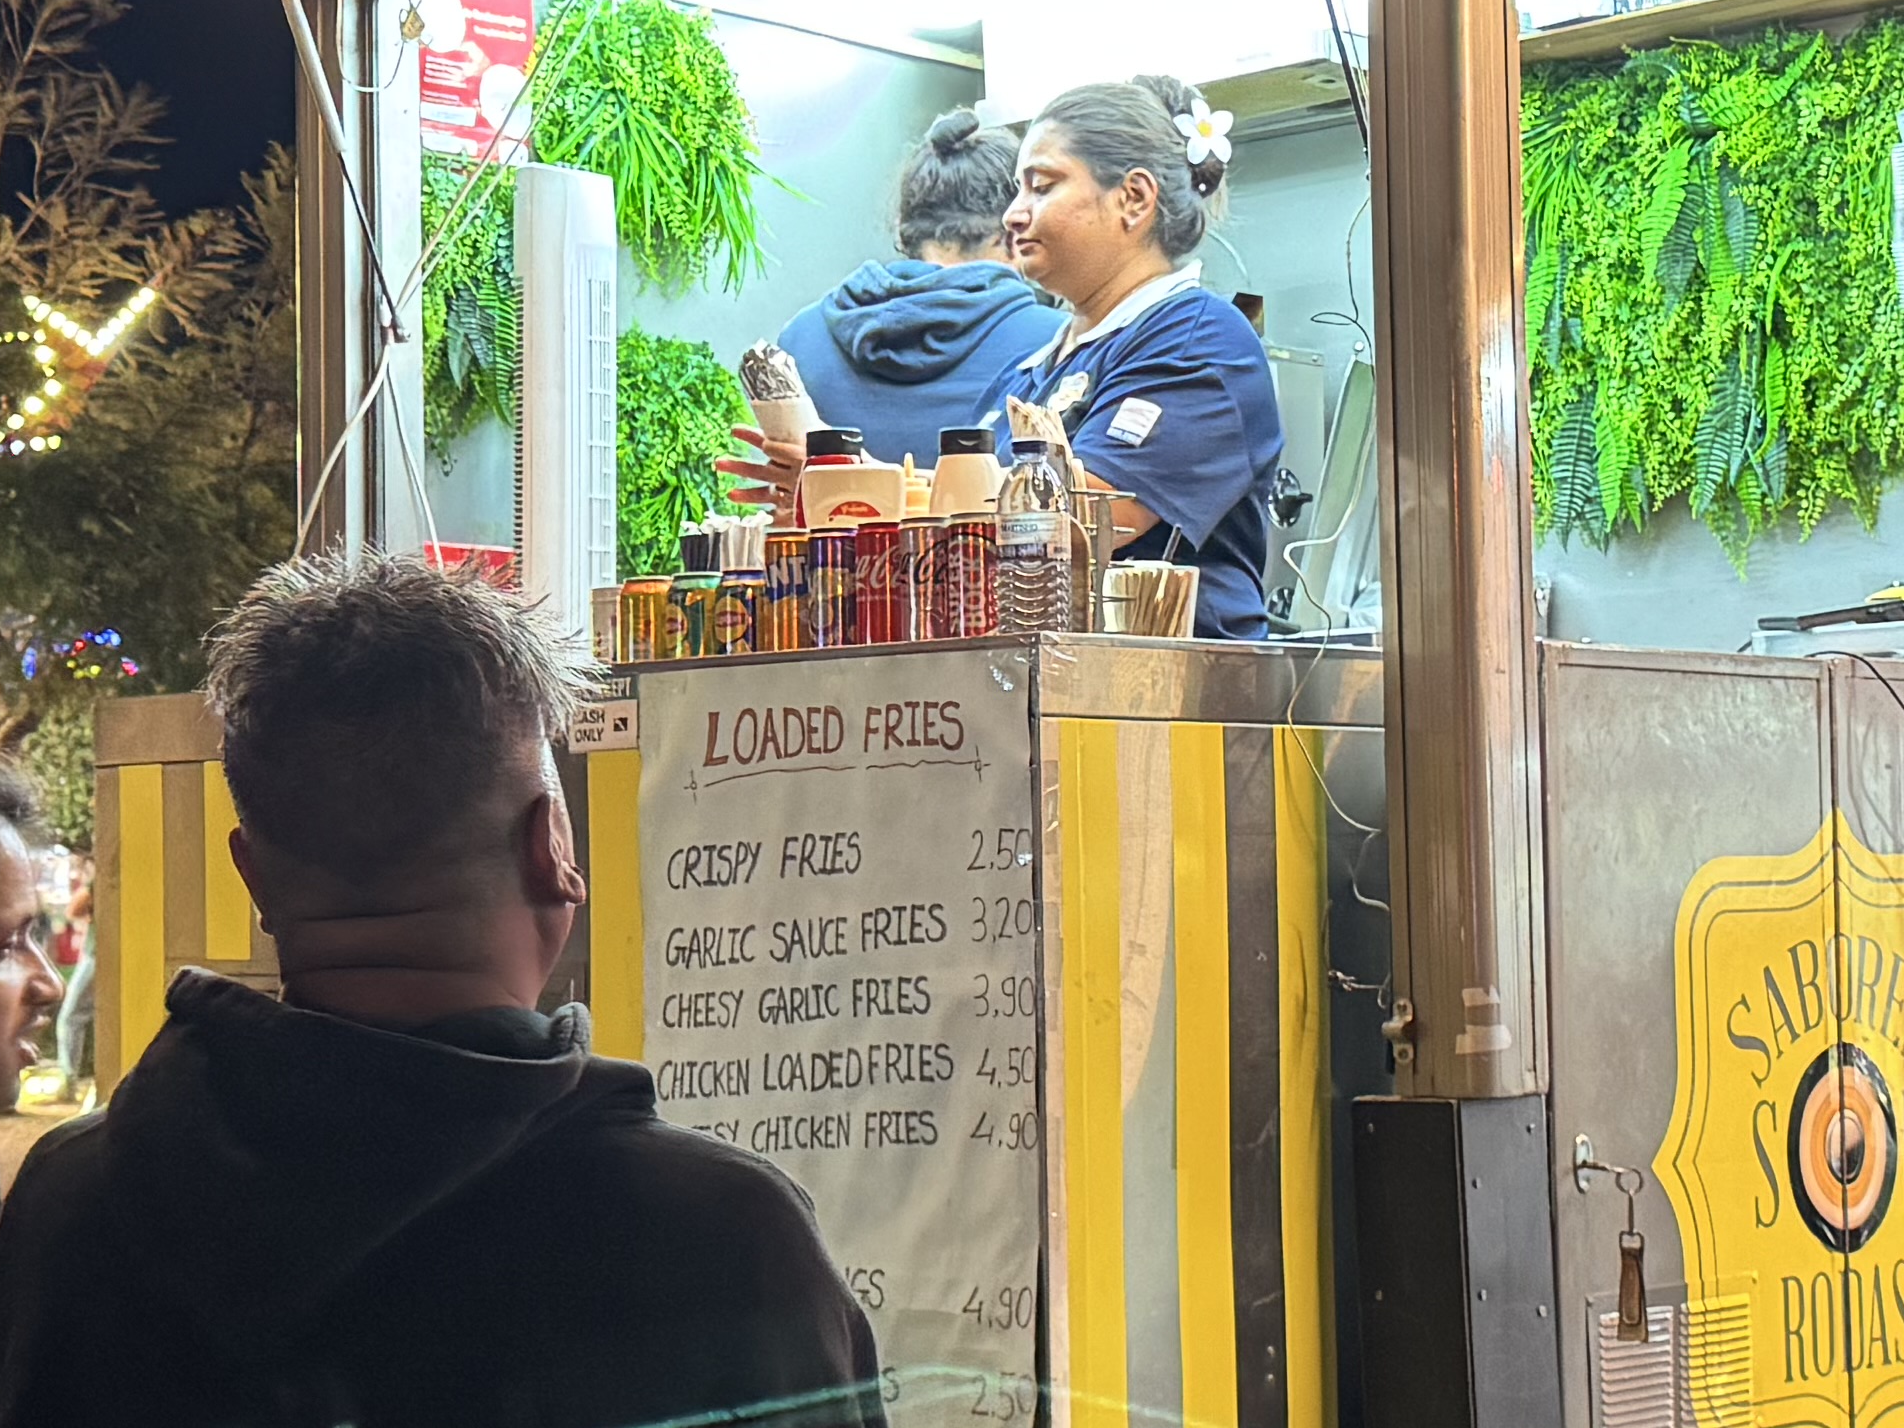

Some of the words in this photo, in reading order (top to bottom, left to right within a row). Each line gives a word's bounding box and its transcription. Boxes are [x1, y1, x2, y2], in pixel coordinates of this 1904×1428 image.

[575, 728, 604, 743] ONLY
[703, 705, 844, 767] LOADED
[864, 700, 964, 753] FRIES
[667, 840, 761, 890] CRISPY
[779, 831, 862, 878] FRIES
[665, 924, 756, 971] GARLIC
[769, 915, 848, 964] SAUCE
[860, 903, 947, 953] FRIES
[662, 989, 743, 1030] CHEESY
[758, 983, 841, 1027] GARLIC
[851, 975, 931, 1018] FRIES
[656, 1058, 751, 1102] CHICKEN
[763, 1048, 862, 1093] LOADED
[868, 1043, 954, 1086] FRIES
[751, 1112, 851, 1154] CHICKEN
[864, 1110, 939, 1149] FRIES
